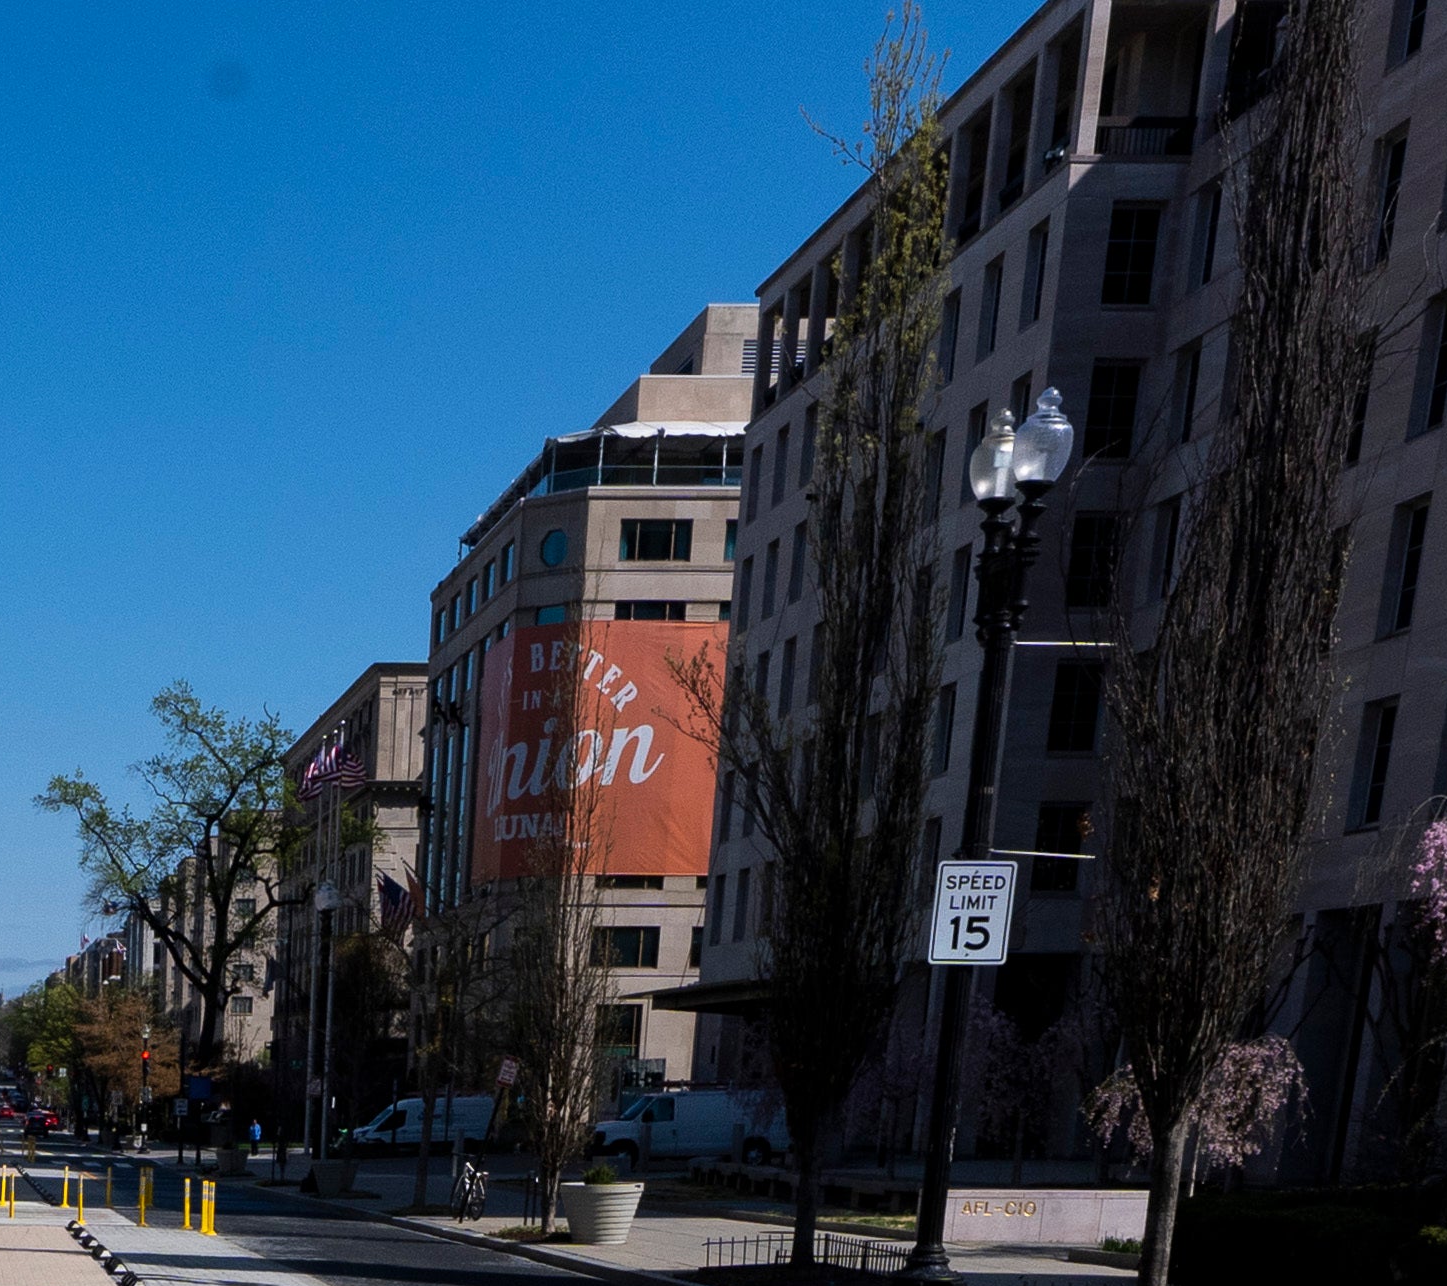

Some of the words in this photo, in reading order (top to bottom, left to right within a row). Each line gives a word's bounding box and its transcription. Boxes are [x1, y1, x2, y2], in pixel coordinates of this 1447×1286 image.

[522, 690, 542, 711] IN
[946, 875, 1006, 890] SPEED
[949, 895, 998, 910] LIMIT
[950, 916, 991, 951] 15
[961, 1201, 1037, 1216] AFL-CIO
